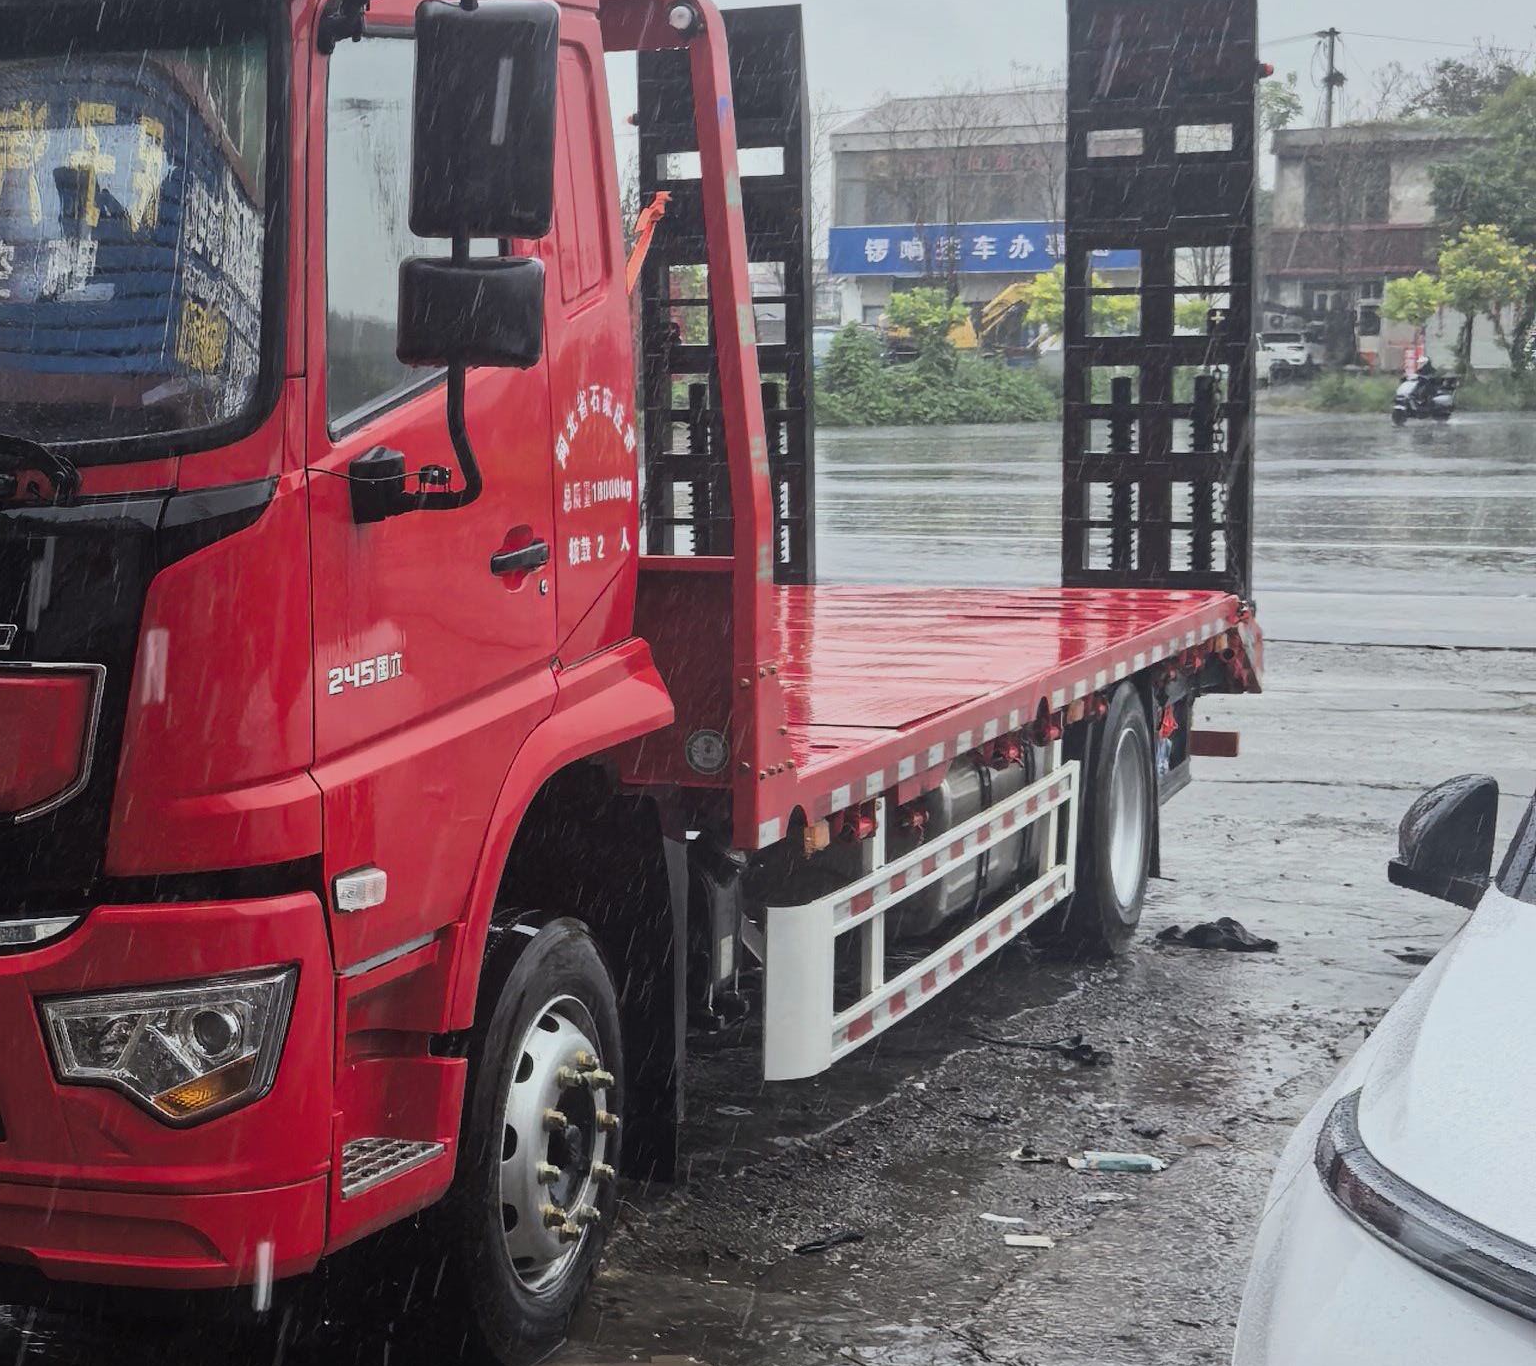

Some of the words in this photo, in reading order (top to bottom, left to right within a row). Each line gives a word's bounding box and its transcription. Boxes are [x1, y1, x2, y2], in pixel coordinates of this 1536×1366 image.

[863, 233, 1111, 263] 锣响挂车办事
